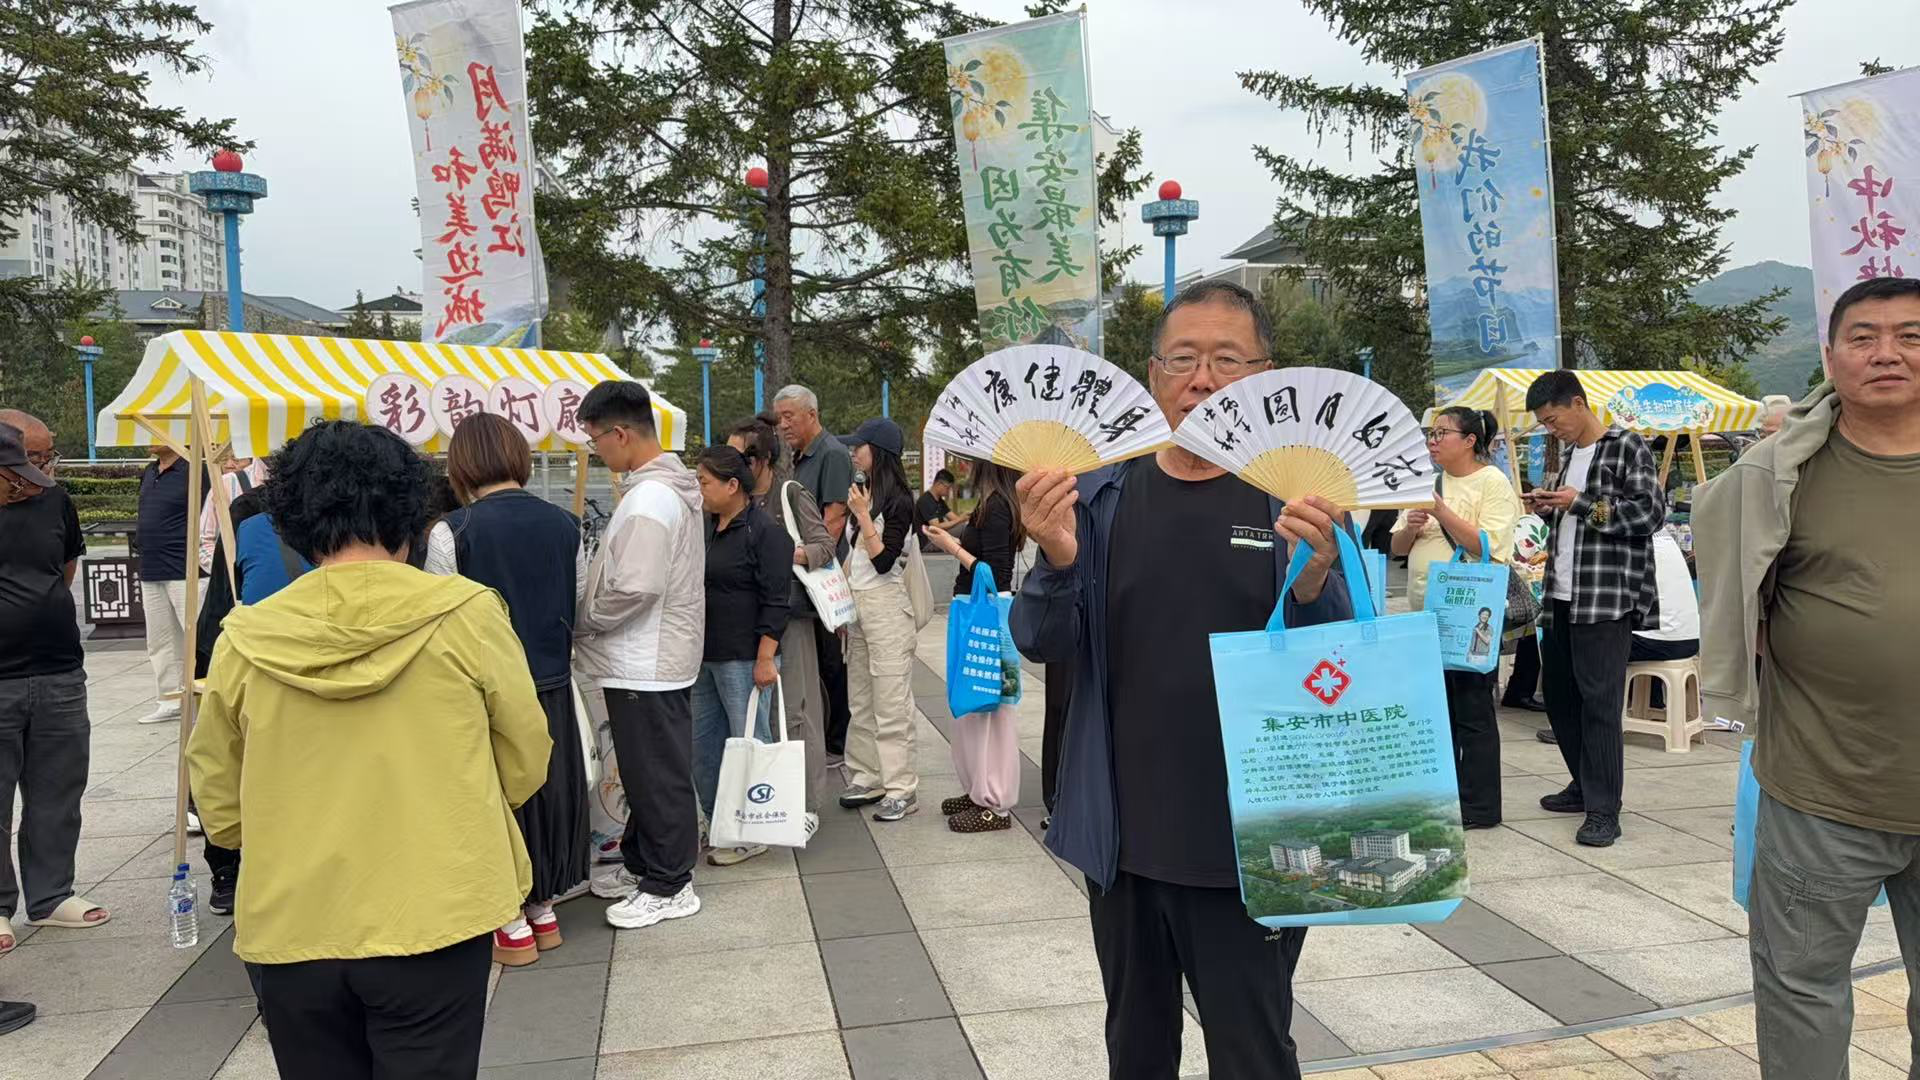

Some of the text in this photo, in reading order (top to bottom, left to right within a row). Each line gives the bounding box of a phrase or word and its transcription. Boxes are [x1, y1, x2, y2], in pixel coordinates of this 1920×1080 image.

[1261, 704, 1408, 732] 集安市中医院
